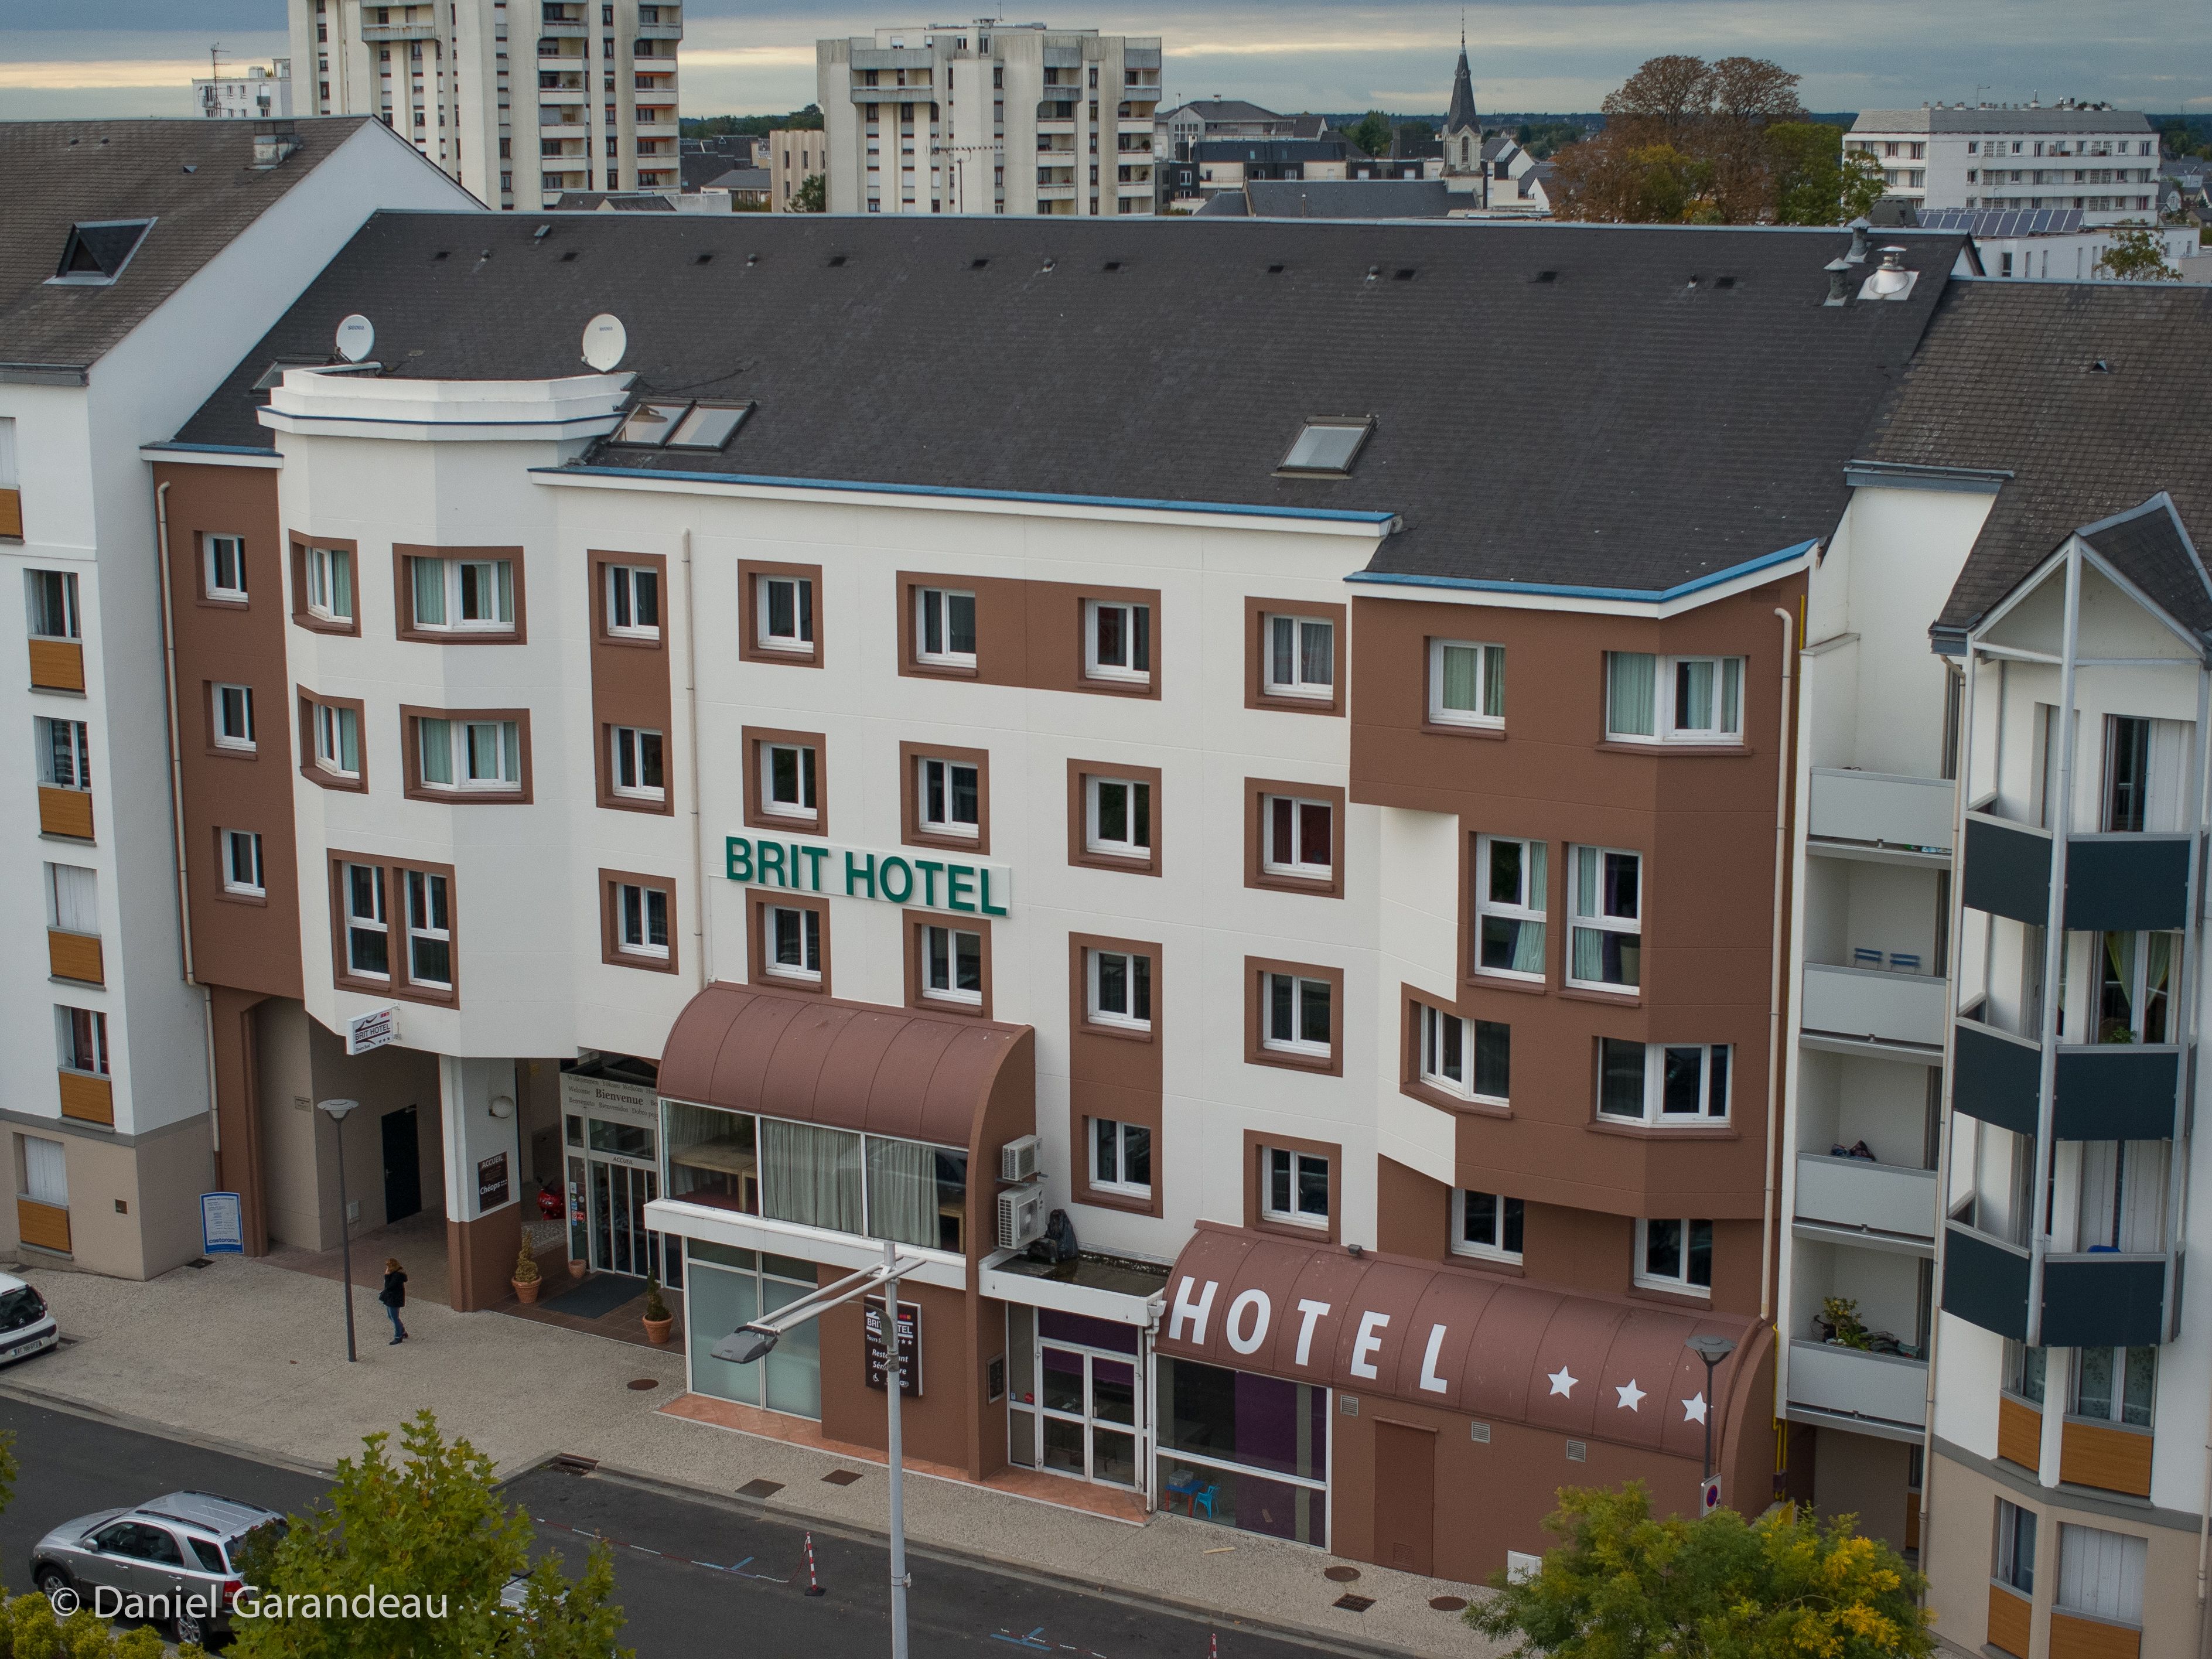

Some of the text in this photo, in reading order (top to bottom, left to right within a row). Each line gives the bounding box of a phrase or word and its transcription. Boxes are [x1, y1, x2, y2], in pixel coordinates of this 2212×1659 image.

[726, 835, 1008, 916] BRIT HOTEL
[355, 1023, 391, 1040] BRIT HOTEL
[568, 1085, 590, 1095] Welcome
[596, 1088, 643, 1105] Bienvenue
[623, 1083, 643, 1093] Welkom
[599, 1102, 629, 1113] Bienvenidos
[482, 1155, 504, 1169] ACCUEIL
[613, 1156, 633, 1165] ACCUEIL
[867, 1334, 878, 1343] Tours
[1169, 1275, 1448, 1394] HOTEL
[872, 1349, 909, 1363] Restnt
[873, 1361, 907, 1374] Sémre
